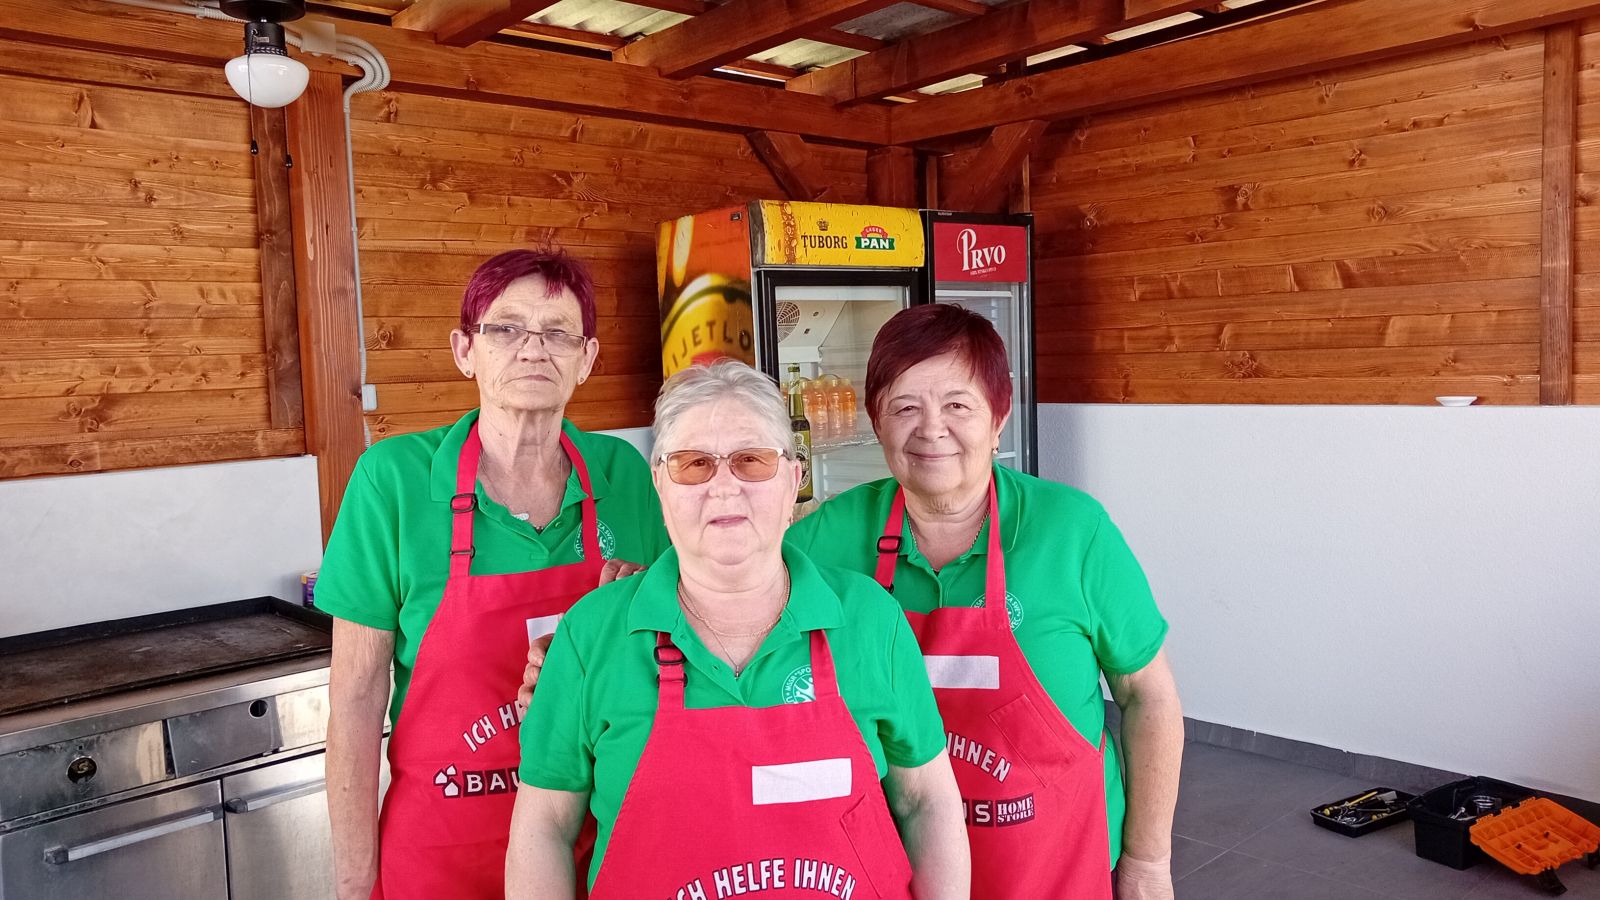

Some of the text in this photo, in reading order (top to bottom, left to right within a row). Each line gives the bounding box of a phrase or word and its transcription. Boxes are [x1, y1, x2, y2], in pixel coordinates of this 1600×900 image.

[800, 234, 848, 249] TUBORG
[861, 237, 890, 249] PAN
[957, 228, 1006, 271] PRVO
[463, 714, 497, 752] ICH
[946, 731, 1012, 783] IHNEN
[997, 796, 1034, 815] HOME
[997, 808, 1034, 823] STORE
[712, 858, 785, 900] HELFE
[793, 858, 857, 900] IHNEN
